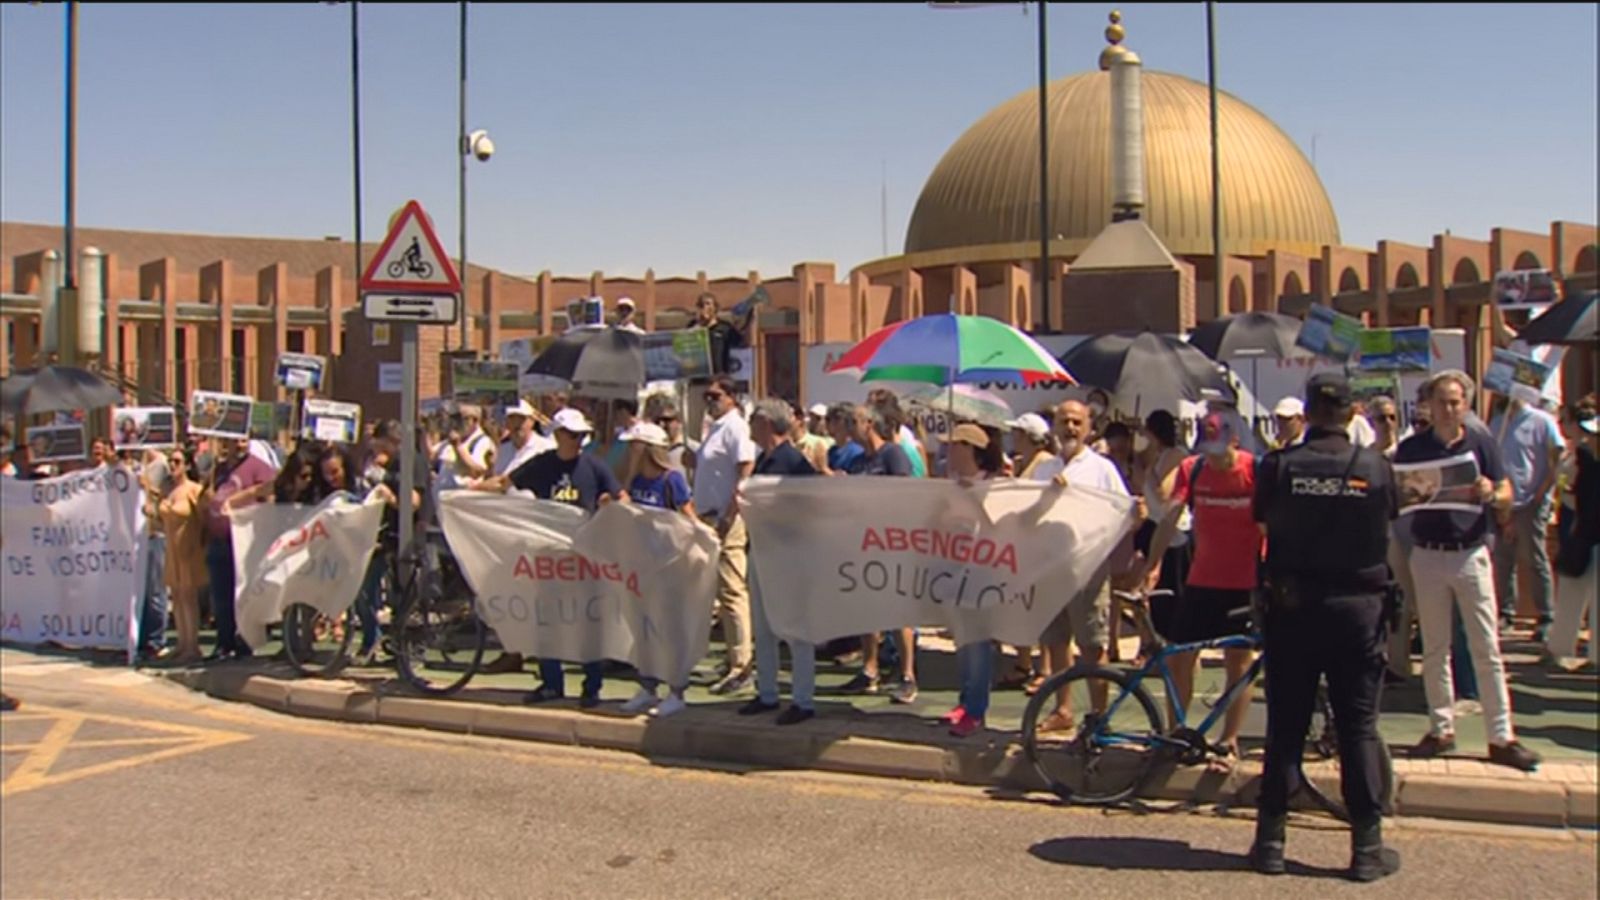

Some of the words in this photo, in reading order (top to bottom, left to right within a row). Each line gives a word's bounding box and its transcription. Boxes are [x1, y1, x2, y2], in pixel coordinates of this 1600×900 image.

[8, 555, 35, 576] DE
[861, 527, 1018, 574] ABENGOA
[513, 555, 642, 598] ABENGA
